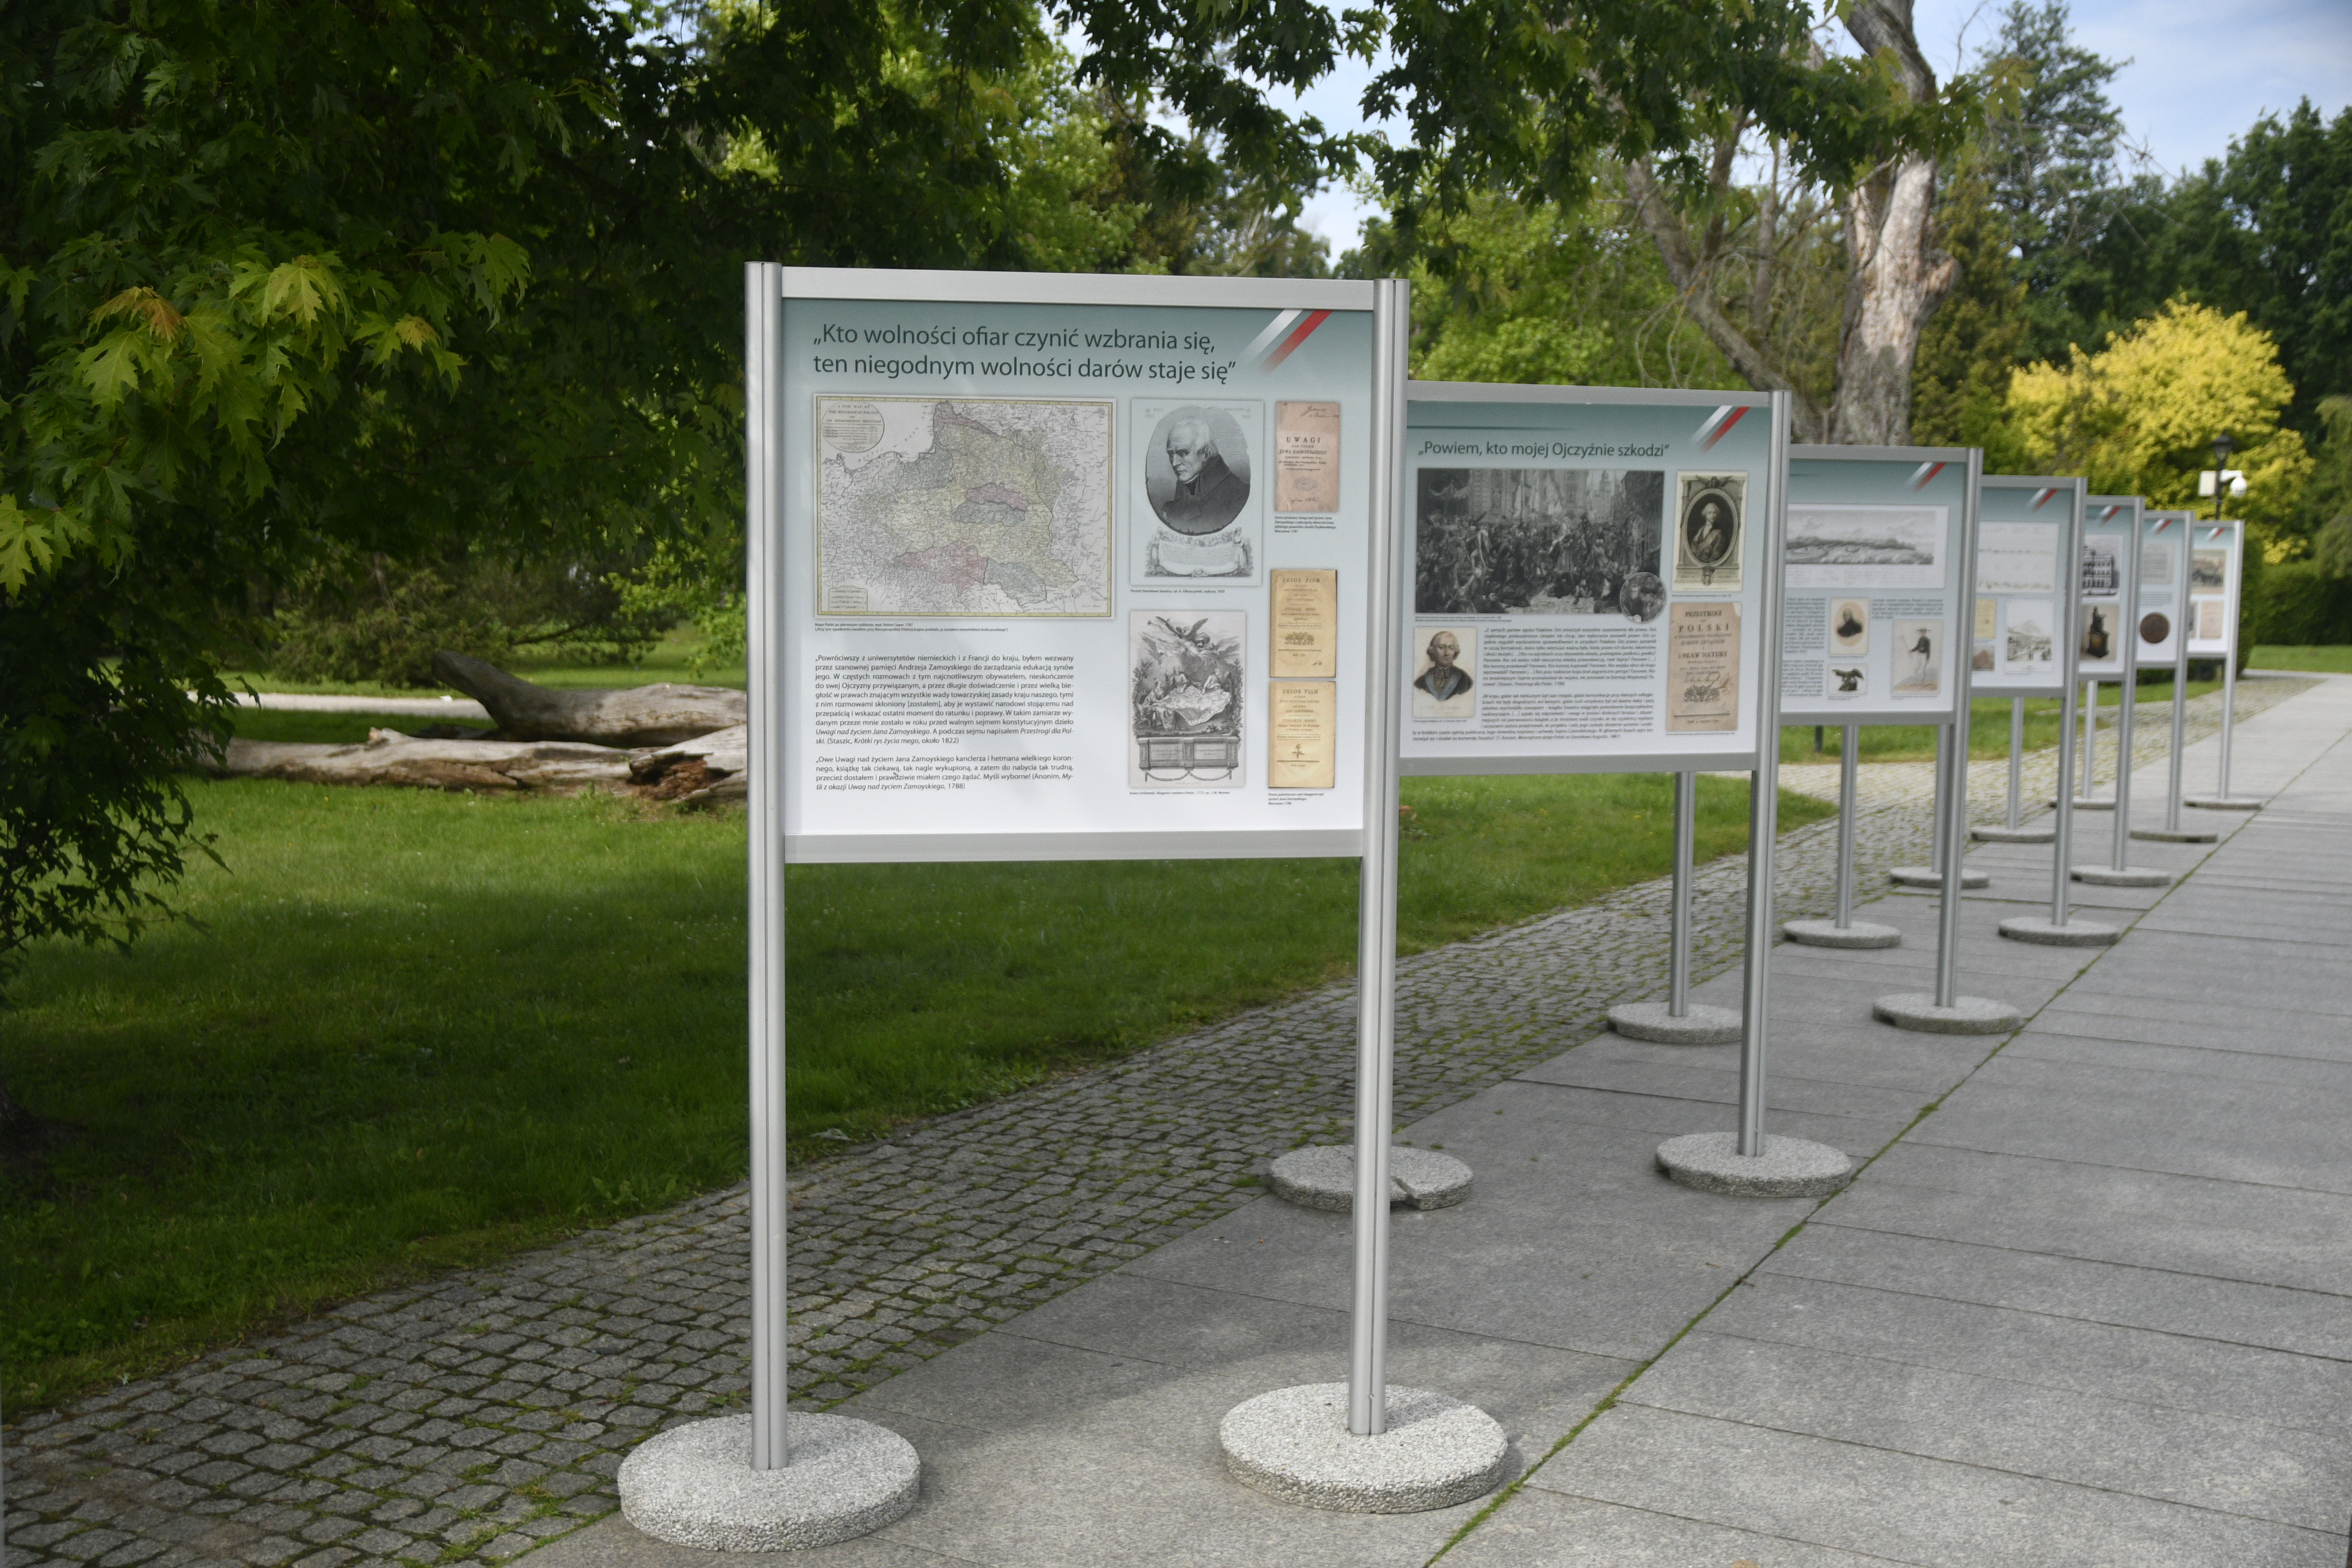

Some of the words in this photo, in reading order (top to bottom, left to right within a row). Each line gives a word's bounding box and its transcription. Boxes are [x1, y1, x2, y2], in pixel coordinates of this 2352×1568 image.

[813, 323, 858, 345] „Kto
[863, 324, 956, 345] wolności
[963, 326, 1009, 346] ofiar
[1015, 328, 1079, 352] czynić
[1084, 328, 1178, 349] wzbrania
[1183, 331, 1215, 354] się,
[813, 355, 848, 373] ten
[854, 355, 974, 380] niegodnym
[981, 357, 1072, 377] wolności
[1078, 358, 1143, 378] darów
[1149, 360, 1196, 384] staje
[1201, 361, 1236, 385] się”
[1418, 440, 1482, 456] „Powiem,
[1486, 442, 1508, 455] kto
[1511, 443, 1549, 458] mojej
[1552, 443, 1615, 458] Ojczyźnie
[1618, 443, 1670, 457] szkodzi”
[1679, 623, 1729, 632] POLSKI
[816, 691, 832, 700] głość
[869, 691, 899, 699] znającym
